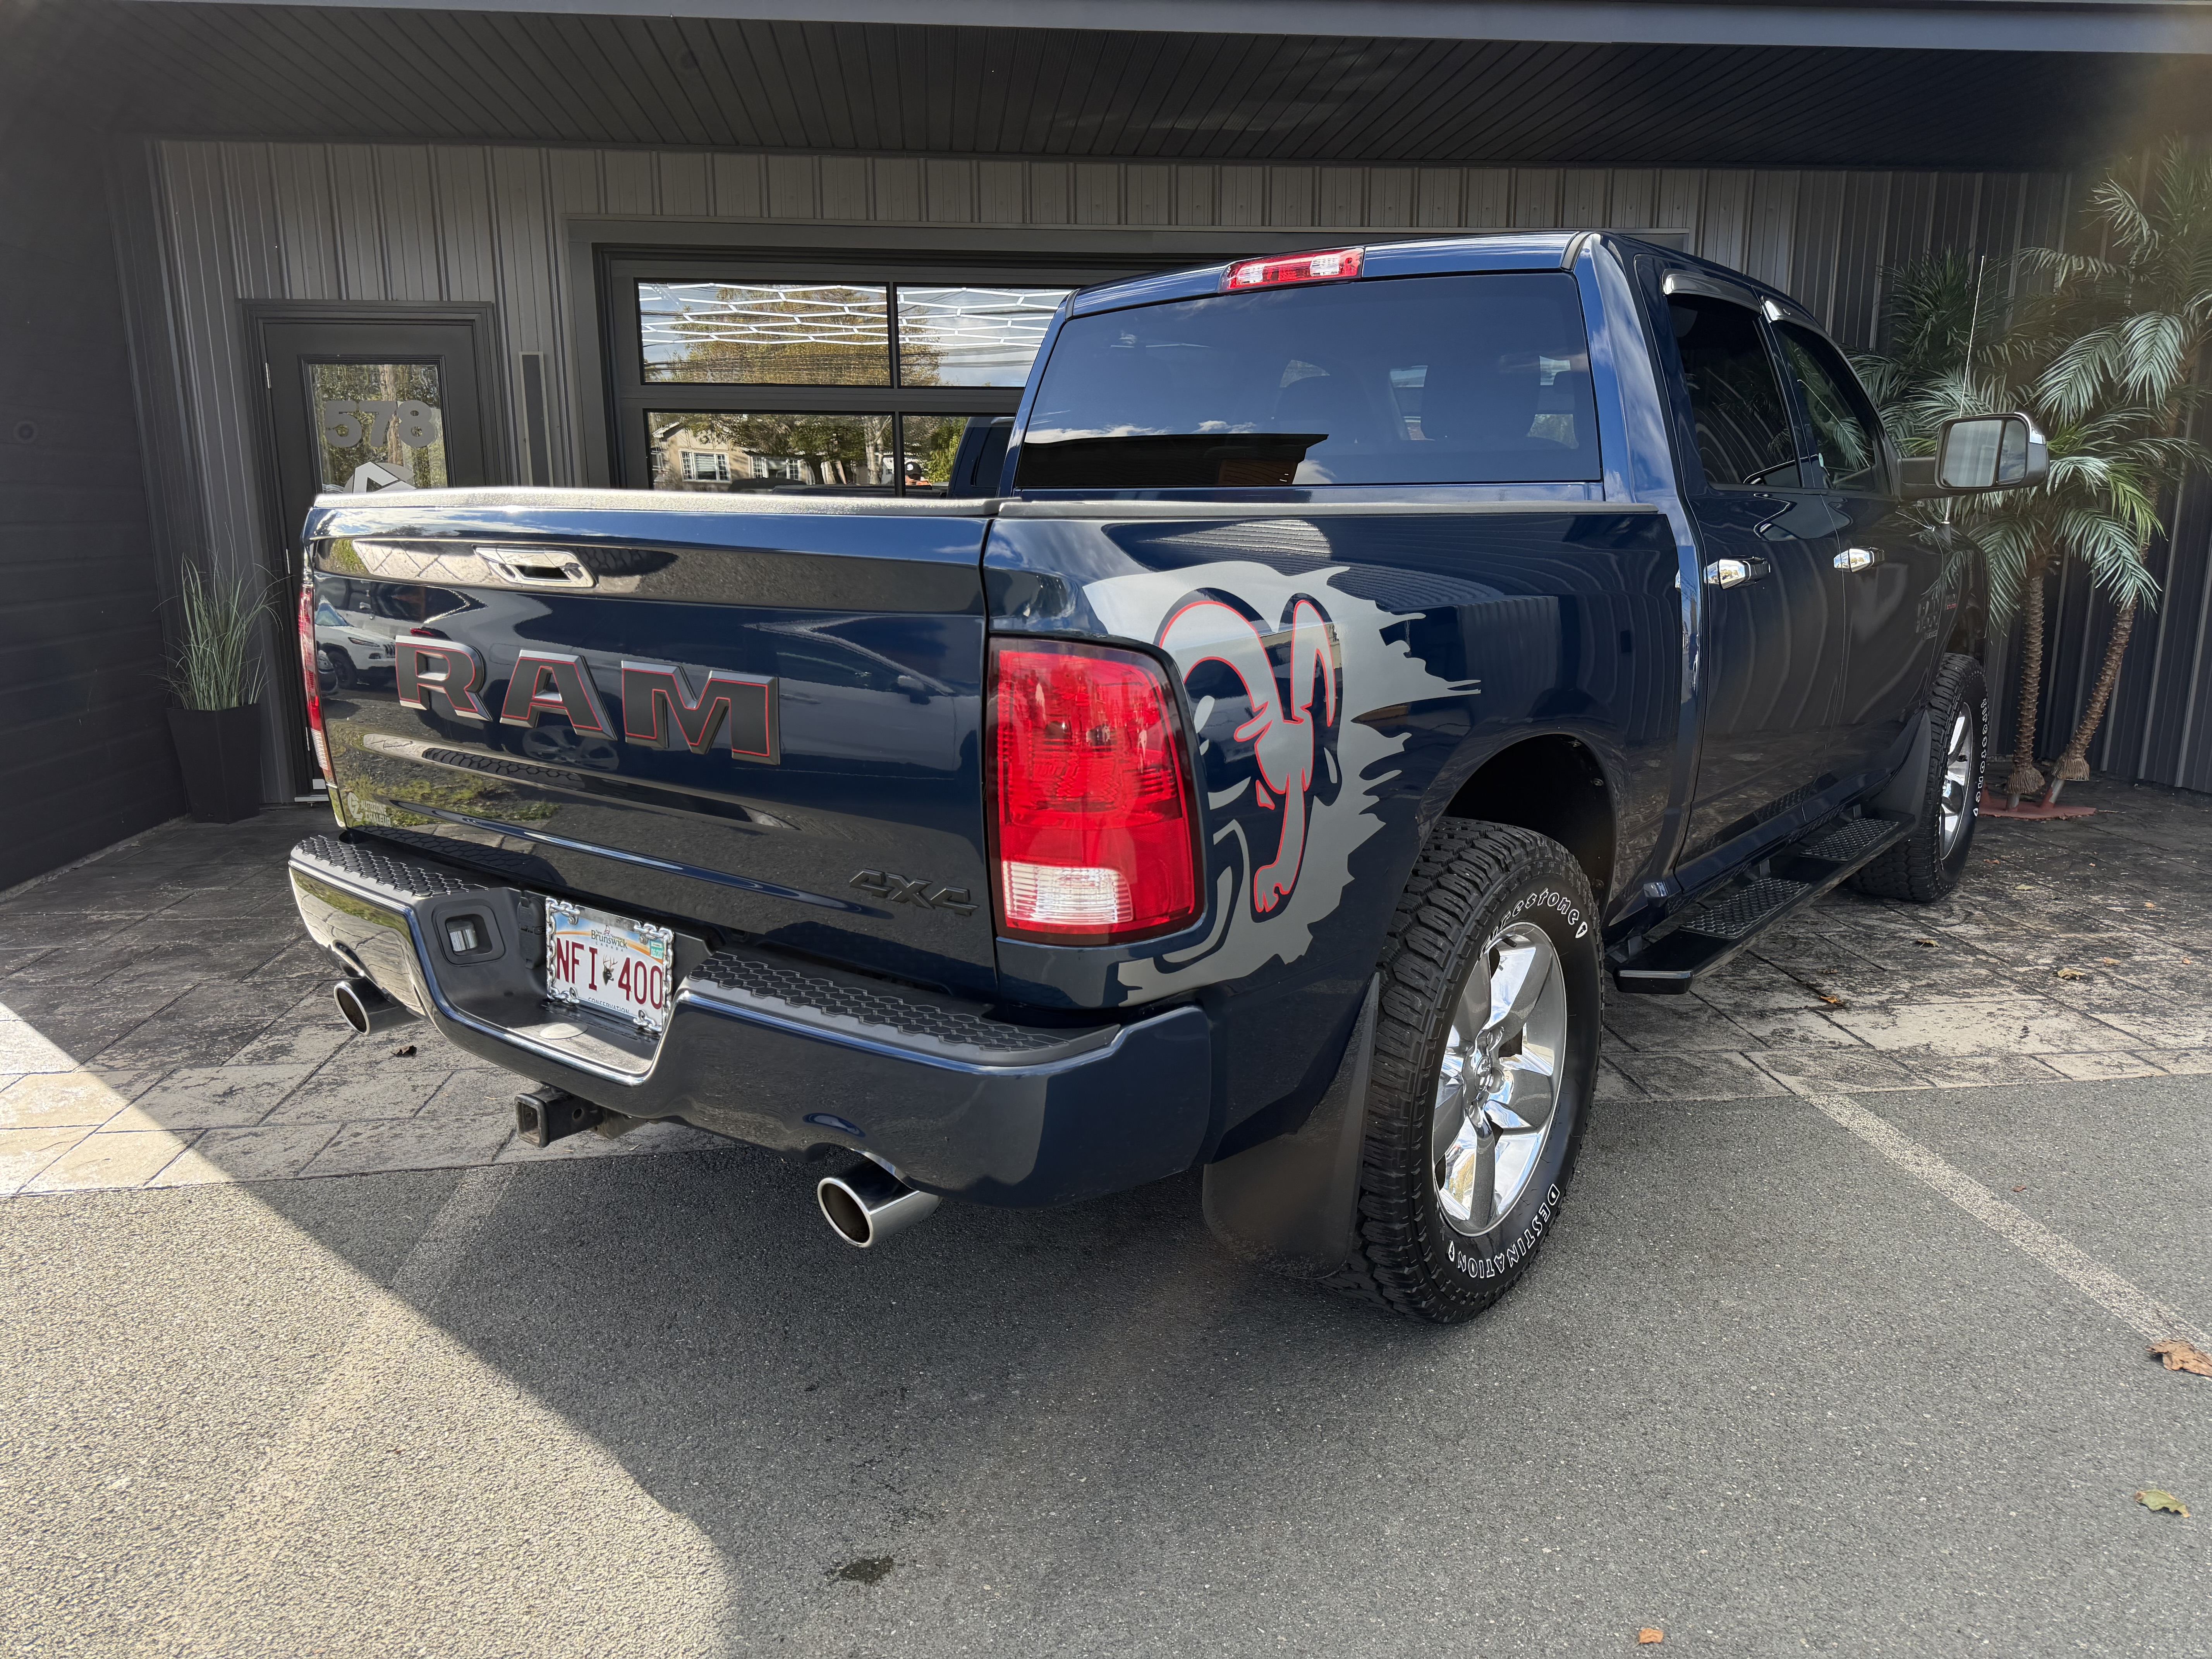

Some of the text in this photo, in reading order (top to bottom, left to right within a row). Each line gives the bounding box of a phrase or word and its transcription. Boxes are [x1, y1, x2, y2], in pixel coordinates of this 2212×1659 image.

[325, 400, 436, 448] 578
[396, 635, 780, 765] RAM
[361, 800, 387, 815] AUTOZONE
[365, 812, 391, 827] CHALEUR
[591, 929, 627, 949] Brunswick
[596, 941, 623, 952] CANADA
[556, 938, 662, 1010] NFI 400
[1458, 1184, 1560, 1278] DESTINATION
